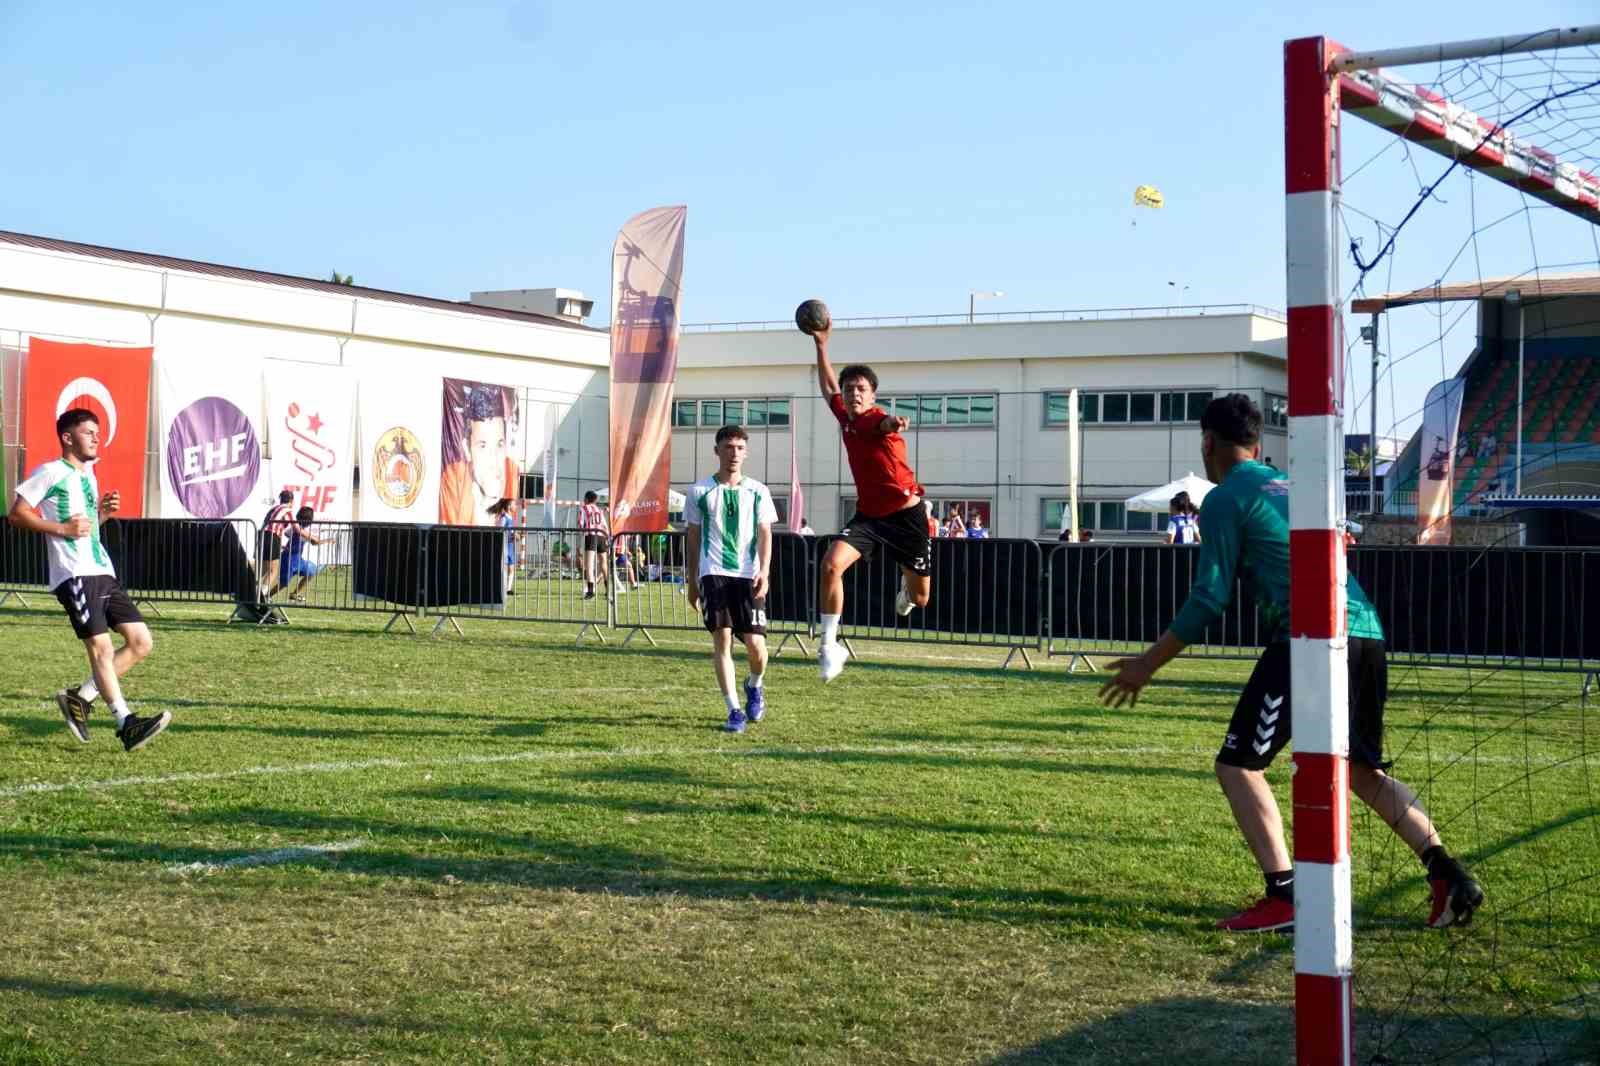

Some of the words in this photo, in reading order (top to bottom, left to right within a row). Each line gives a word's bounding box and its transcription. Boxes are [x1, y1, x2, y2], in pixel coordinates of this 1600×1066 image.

[183, 432, 247, 477] EHF
[590, 511, 601, 525] 10
[1182, 527, 1194, 544] 10
